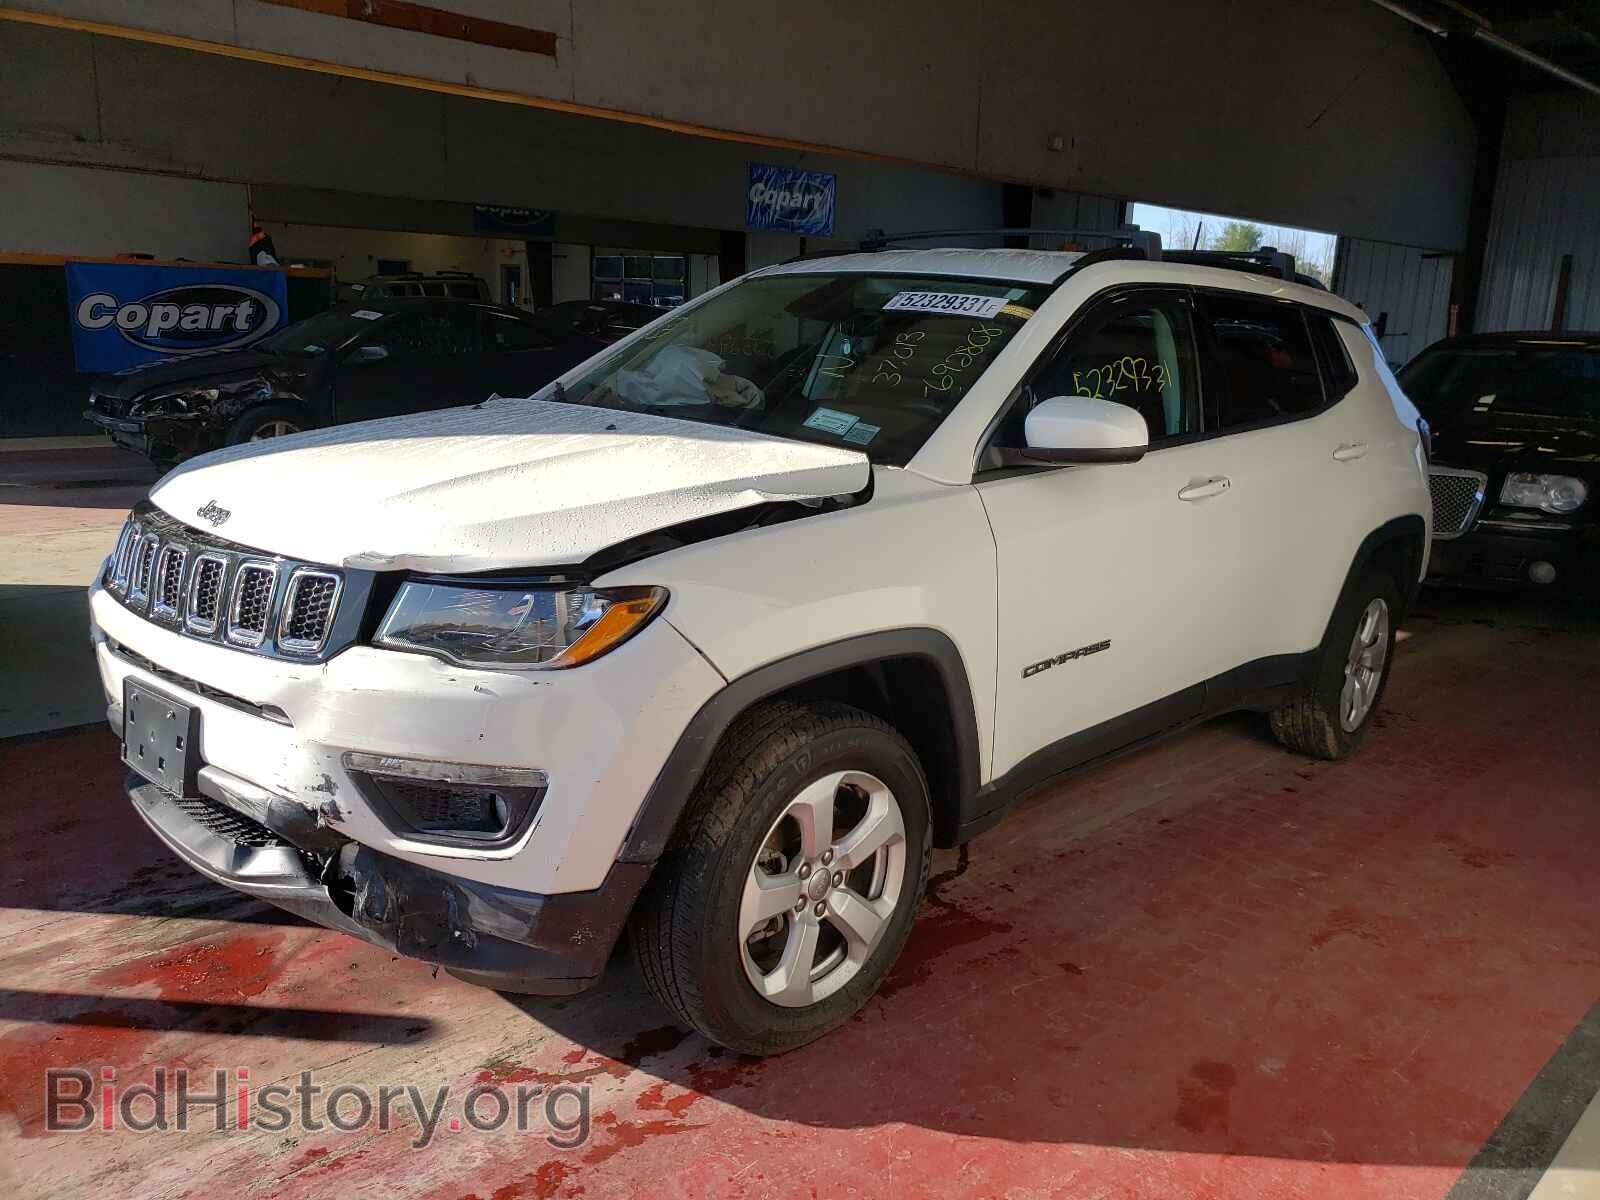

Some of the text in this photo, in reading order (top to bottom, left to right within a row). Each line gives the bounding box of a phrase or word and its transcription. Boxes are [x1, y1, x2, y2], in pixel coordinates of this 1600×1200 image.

[749, 181, 823, 210] Copart
[77, 291, 256, 340] Copart
[899, 293, 991, 313] 52329331
[196, 499, 231, 527] Jeep
[1022, 639, 1111, 679] COMPASS
